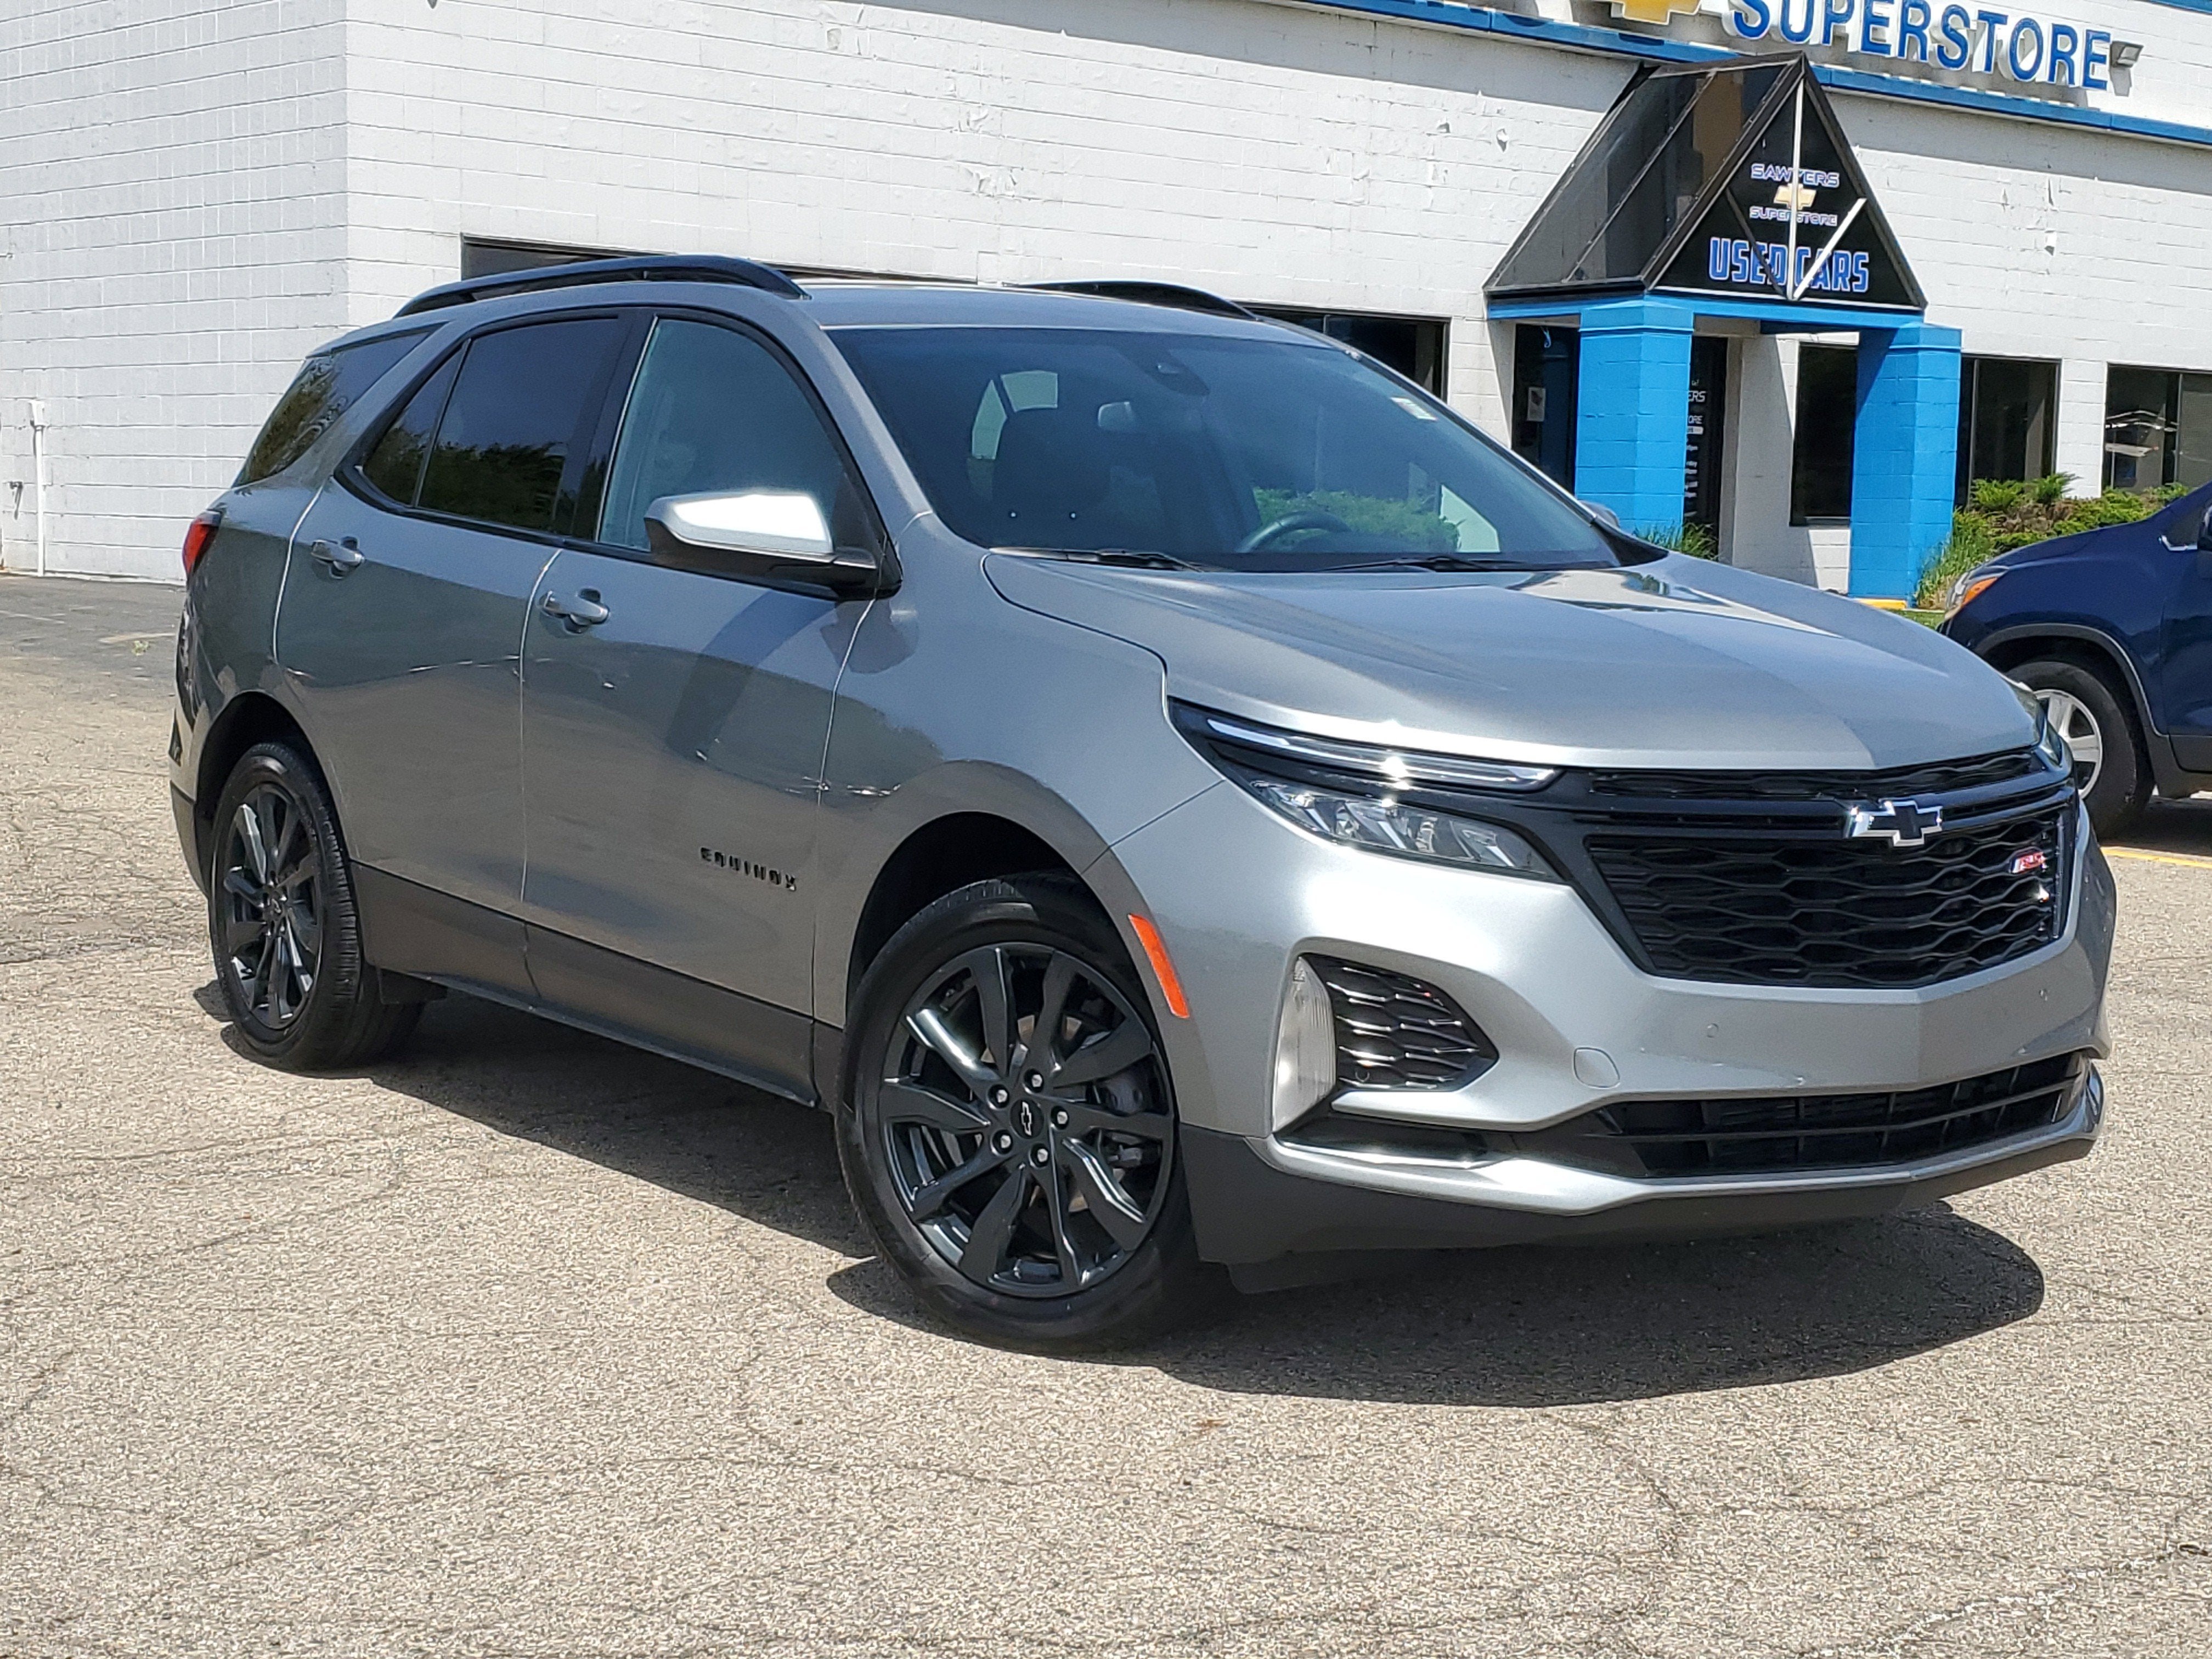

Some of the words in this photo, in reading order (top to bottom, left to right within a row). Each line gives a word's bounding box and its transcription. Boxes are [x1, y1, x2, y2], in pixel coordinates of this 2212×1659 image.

[1734, 0, 2112, 90] SUPERSTORE
[1751, 163, 1839, 188] SAWYERS
[1750, 206, 1837, 227] SUPERSTORE
[1709, 237, 1787, 286] USED
[1794, 246, 1869, 292] CARS
[700, 847, 796, 891] EQUINOX
